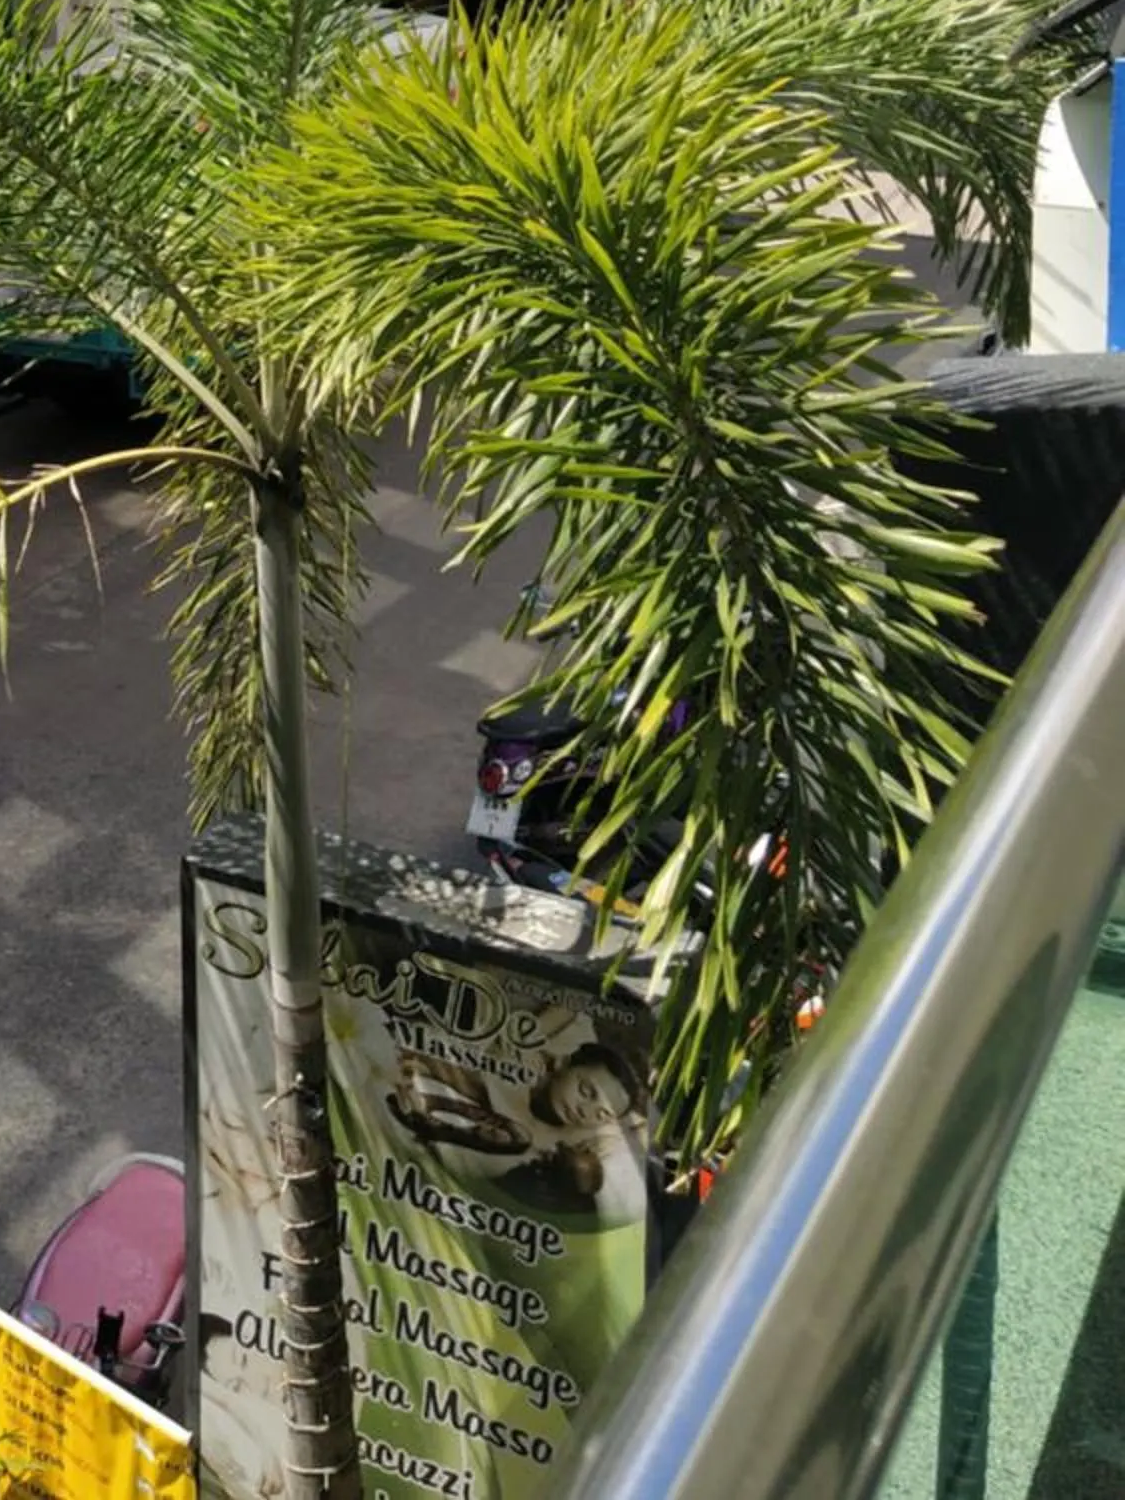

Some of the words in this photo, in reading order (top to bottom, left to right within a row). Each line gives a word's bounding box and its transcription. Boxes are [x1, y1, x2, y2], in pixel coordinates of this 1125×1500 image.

[383, 1018, 537, 1087] Massage
[382, 1157, 565, 1260] Massage
[365, 1221, 547, 1327] Massage
[395, 1301, 579, 1410] Massage
[356, 1435, 473, 1500] acuzzi
